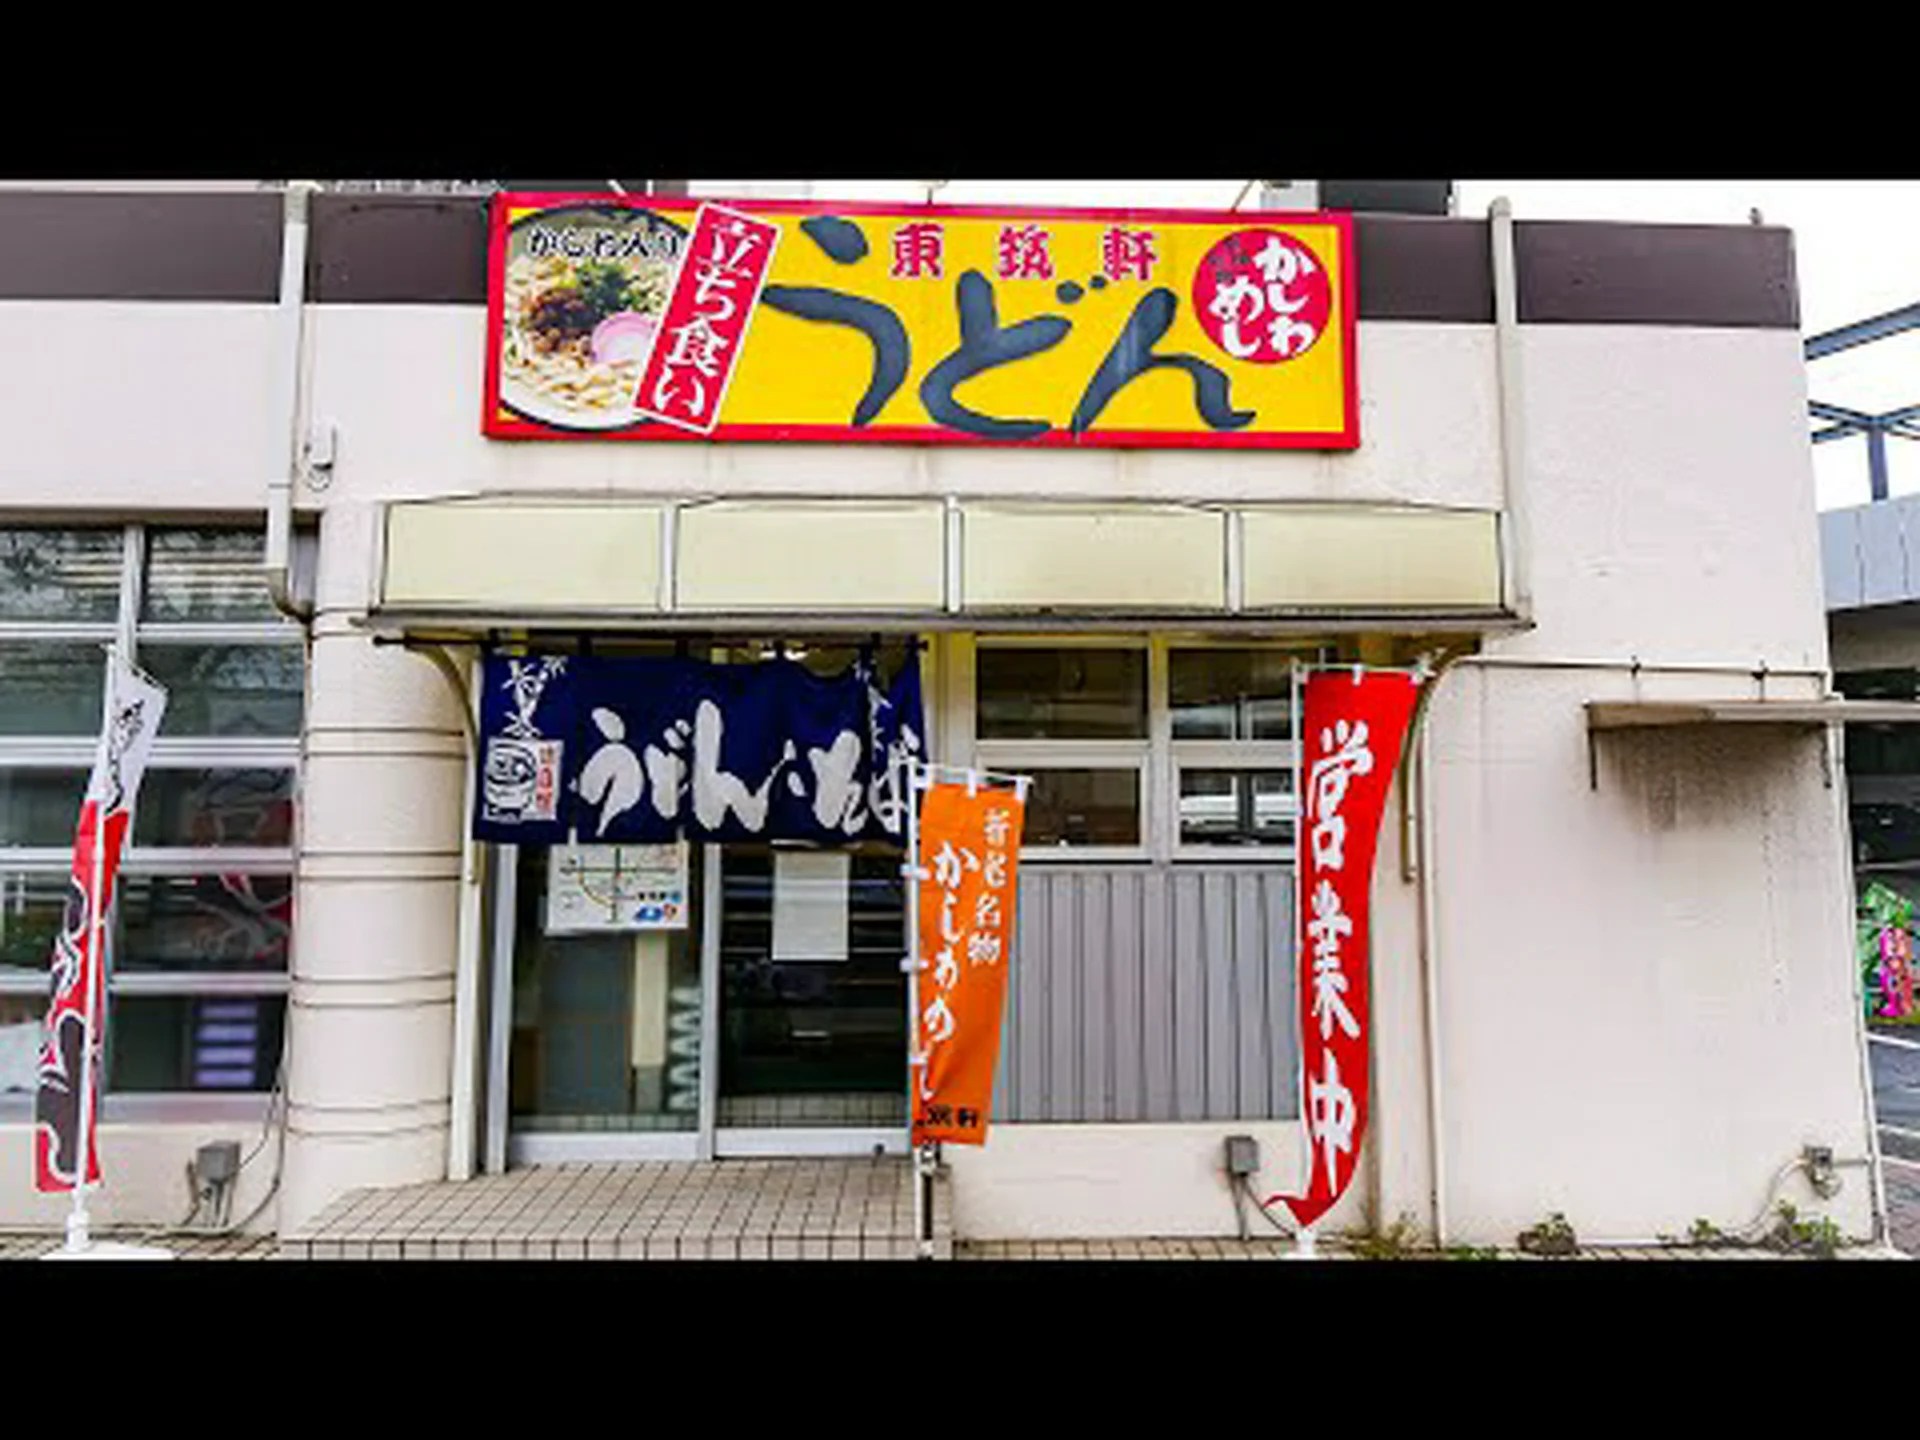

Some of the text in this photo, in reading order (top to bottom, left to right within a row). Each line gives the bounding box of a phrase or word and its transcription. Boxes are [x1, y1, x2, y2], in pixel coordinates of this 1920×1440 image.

[651, 219, 764, 418] 立ち食い
[760, 215, 1257, 440] うどん
[890, 222, 1159, 281] 東筑軒
[1208, 275, 1265, 358] めし
[1252, 235, 1317, 356] かしわ
[1307, 718, 1375, 1199] 営業中
